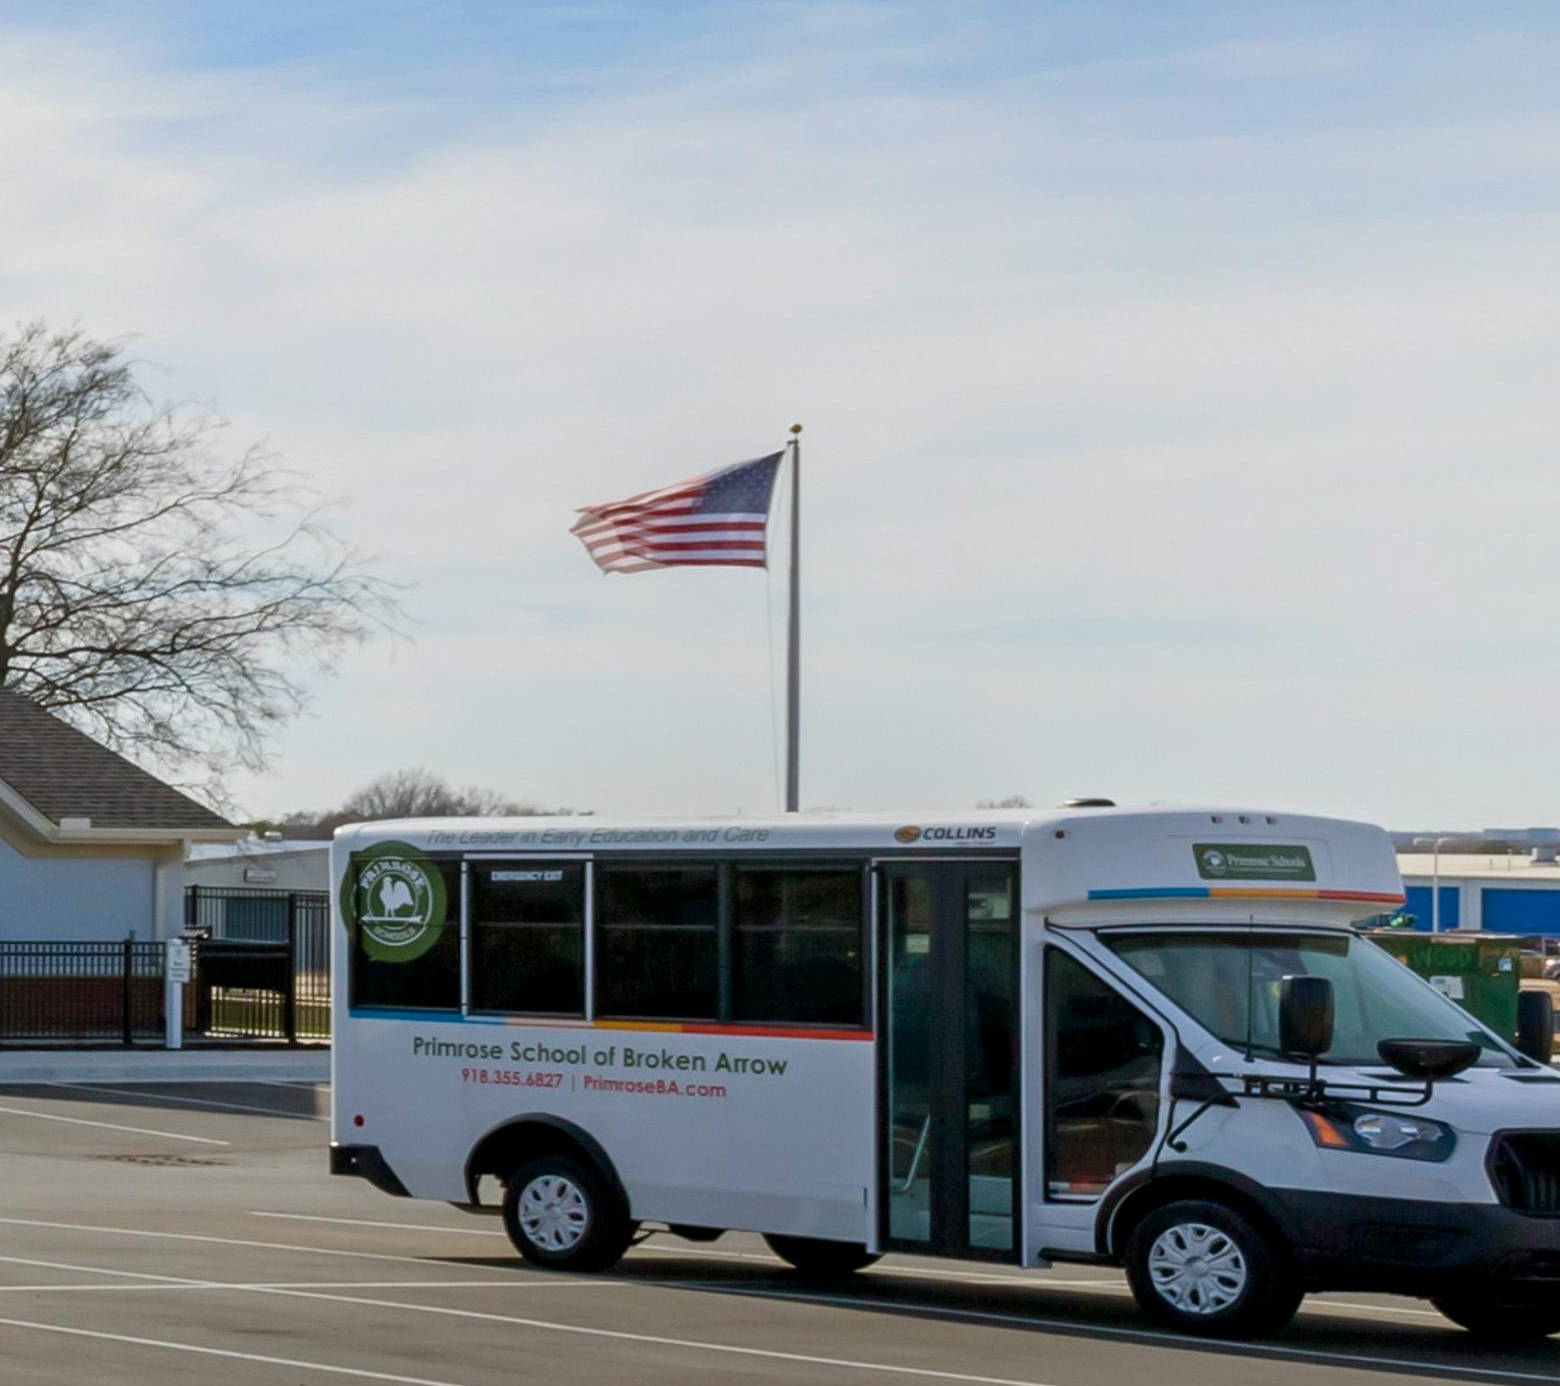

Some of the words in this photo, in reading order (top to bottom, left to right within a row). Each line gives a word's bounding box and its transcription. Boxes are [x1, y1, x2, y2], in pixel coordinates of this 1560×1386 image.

[426, 829, 456, 845] The
[459, 829, 516, 845] Leader
[520, 829, 537, 844] in
[541, 828, 586, 847] Early
[590, 827, 680, 844] Education
[681, 827, 720, 843] and
[724, 826, 770, 843] Care
[922, 826, 997, 840] COLLINS
[359, 860, 426, 895] PRIMROSE
[412, 1036, 504, 1060] Primrose
[509, 1041, 587, 1065] School
[593, 1045, 617, 1067] of
[623, 1047, 707, 1072] Broken
[714, 1052, 789, 1076] Arrow
[461, 1068, 564, 1089] 918.355.6827
[582, 1075, 728, 1098] PrimroseBA.com
